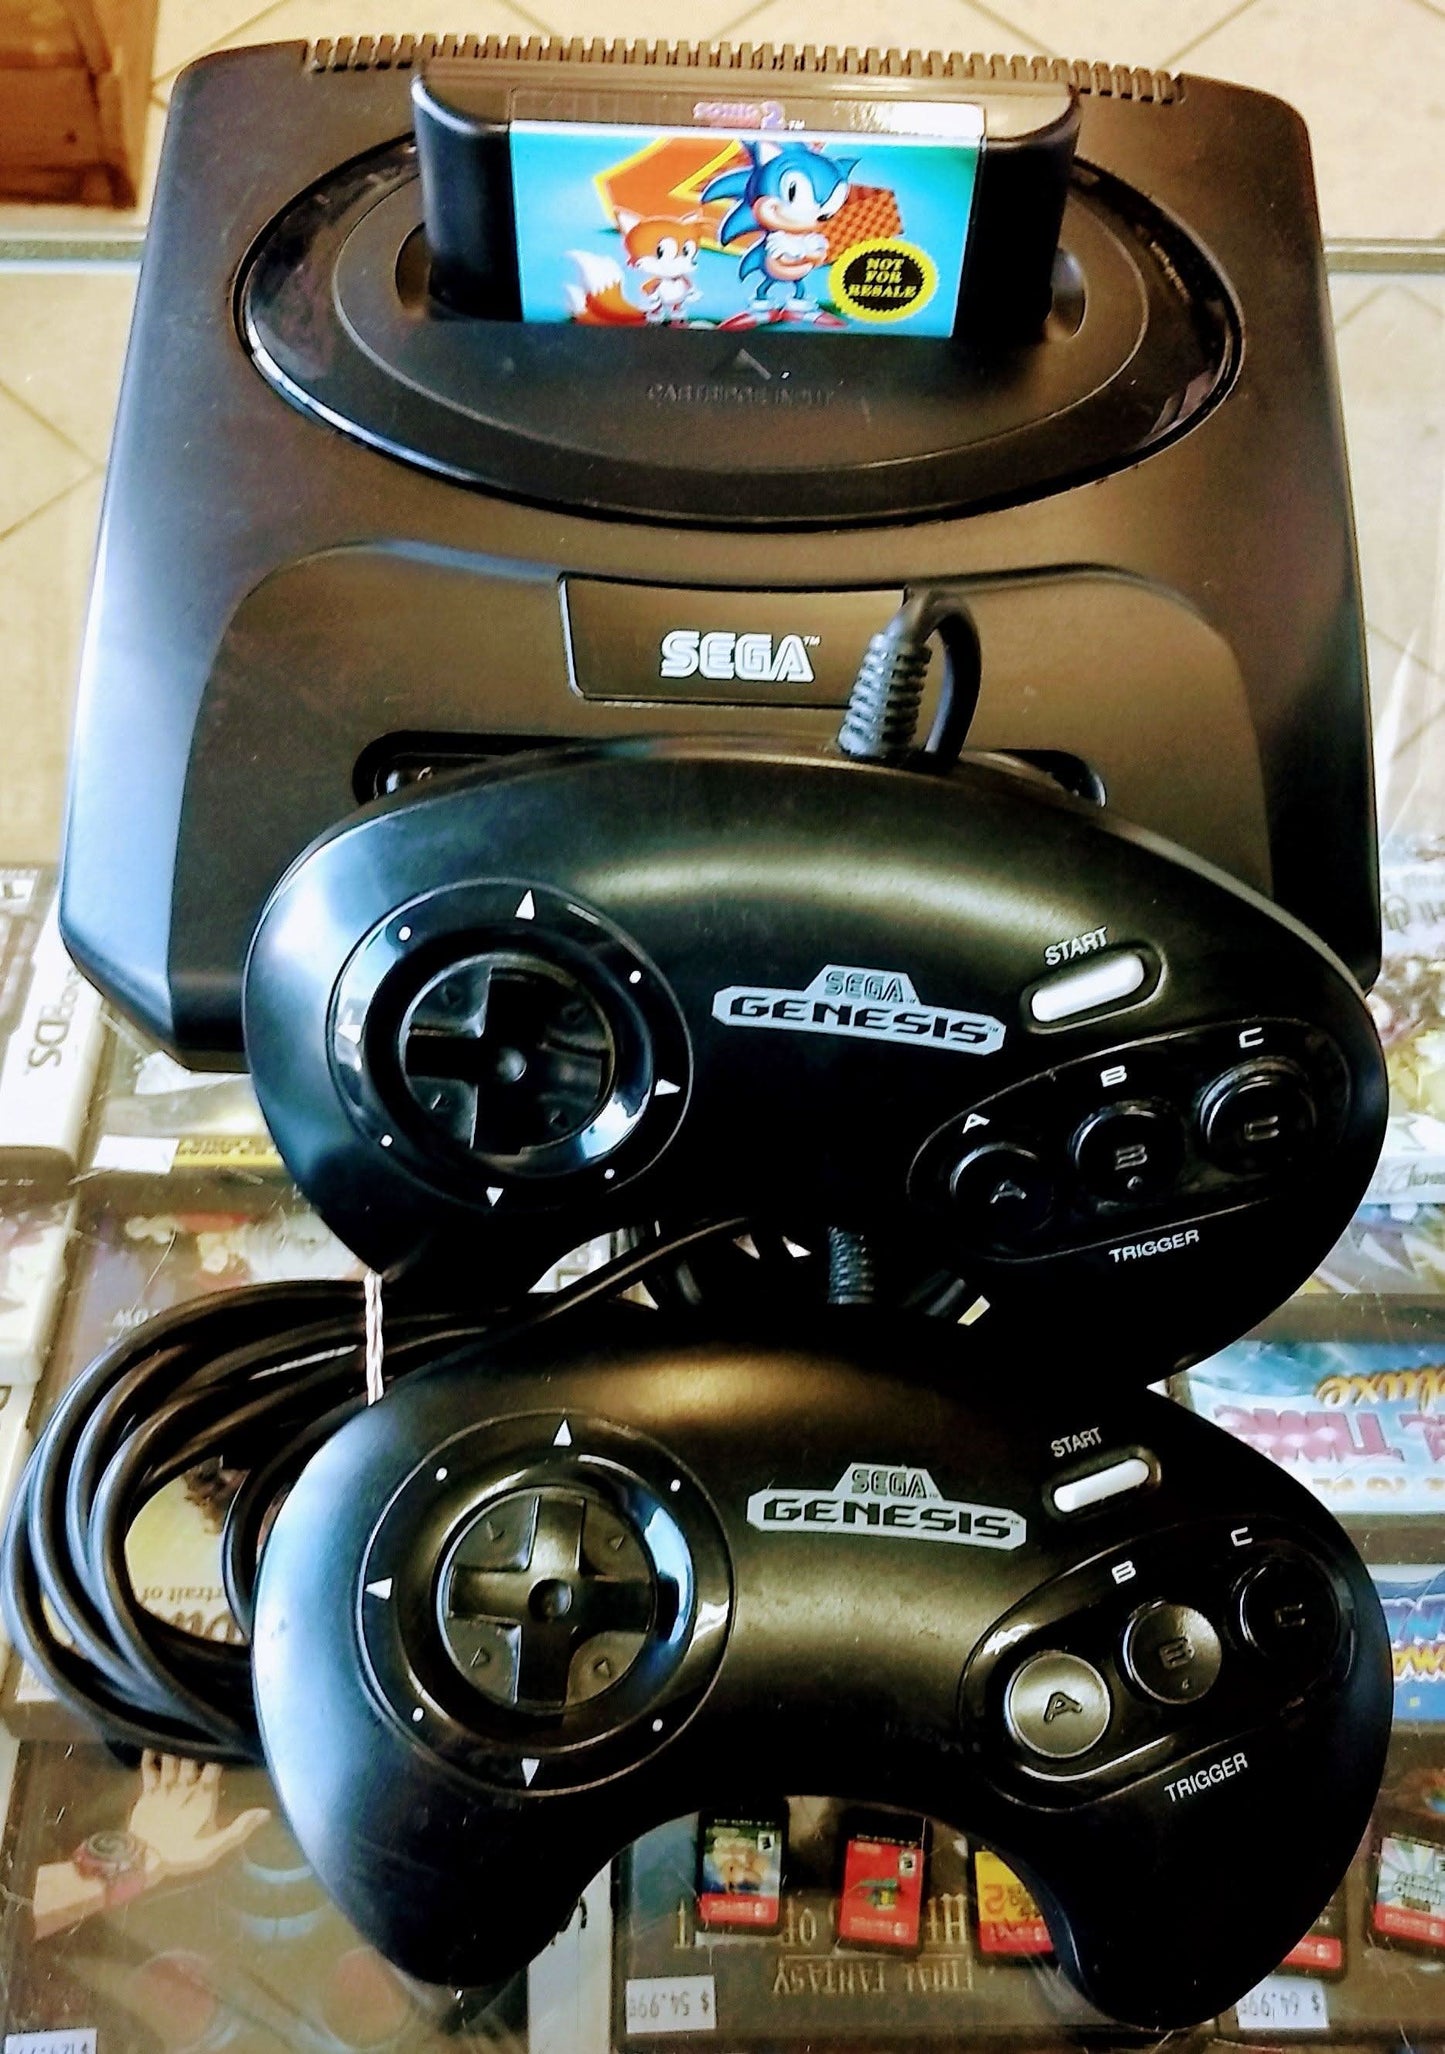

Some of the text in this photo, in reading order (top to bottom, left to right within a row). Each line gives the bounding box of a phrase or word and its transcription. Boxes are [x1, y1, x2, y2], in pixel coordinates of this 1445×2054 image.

[864, 270, 903, 284] FOR
[865, 258, 905, 271] NOT
[848, 284, 918, 298] RESALE
[660, 630, 816, 683] SEGA
[1044, 926, 1109, 967] START
[825, 970, 904, 1003] SEGA
[729, 996, 989, 1045] GENESIS
[1238, 1026, 1265, 1048] C
[1101, 1065, 1128, 1088] B
[962, 1112, 991, 1134] A
[1108, 1228, 1201, 1264] TRIGGER
[1050, 1427, 1102, 1458] START
[851, 1468, 927, 1500] SEGA
[763, 1498, 1011, 1540] GENESIS
[1230, 1526, 1253, 1547] C
[1111, 1560, 1137, 1585] B
[168, 1586, 224, 1605] rtrait
[1042, 1691, 1084, 1725] A
[1164, 1752, 1250, 1803] TRIGGER
[771, 1959, 974, 1995] FINAL FANTASY
